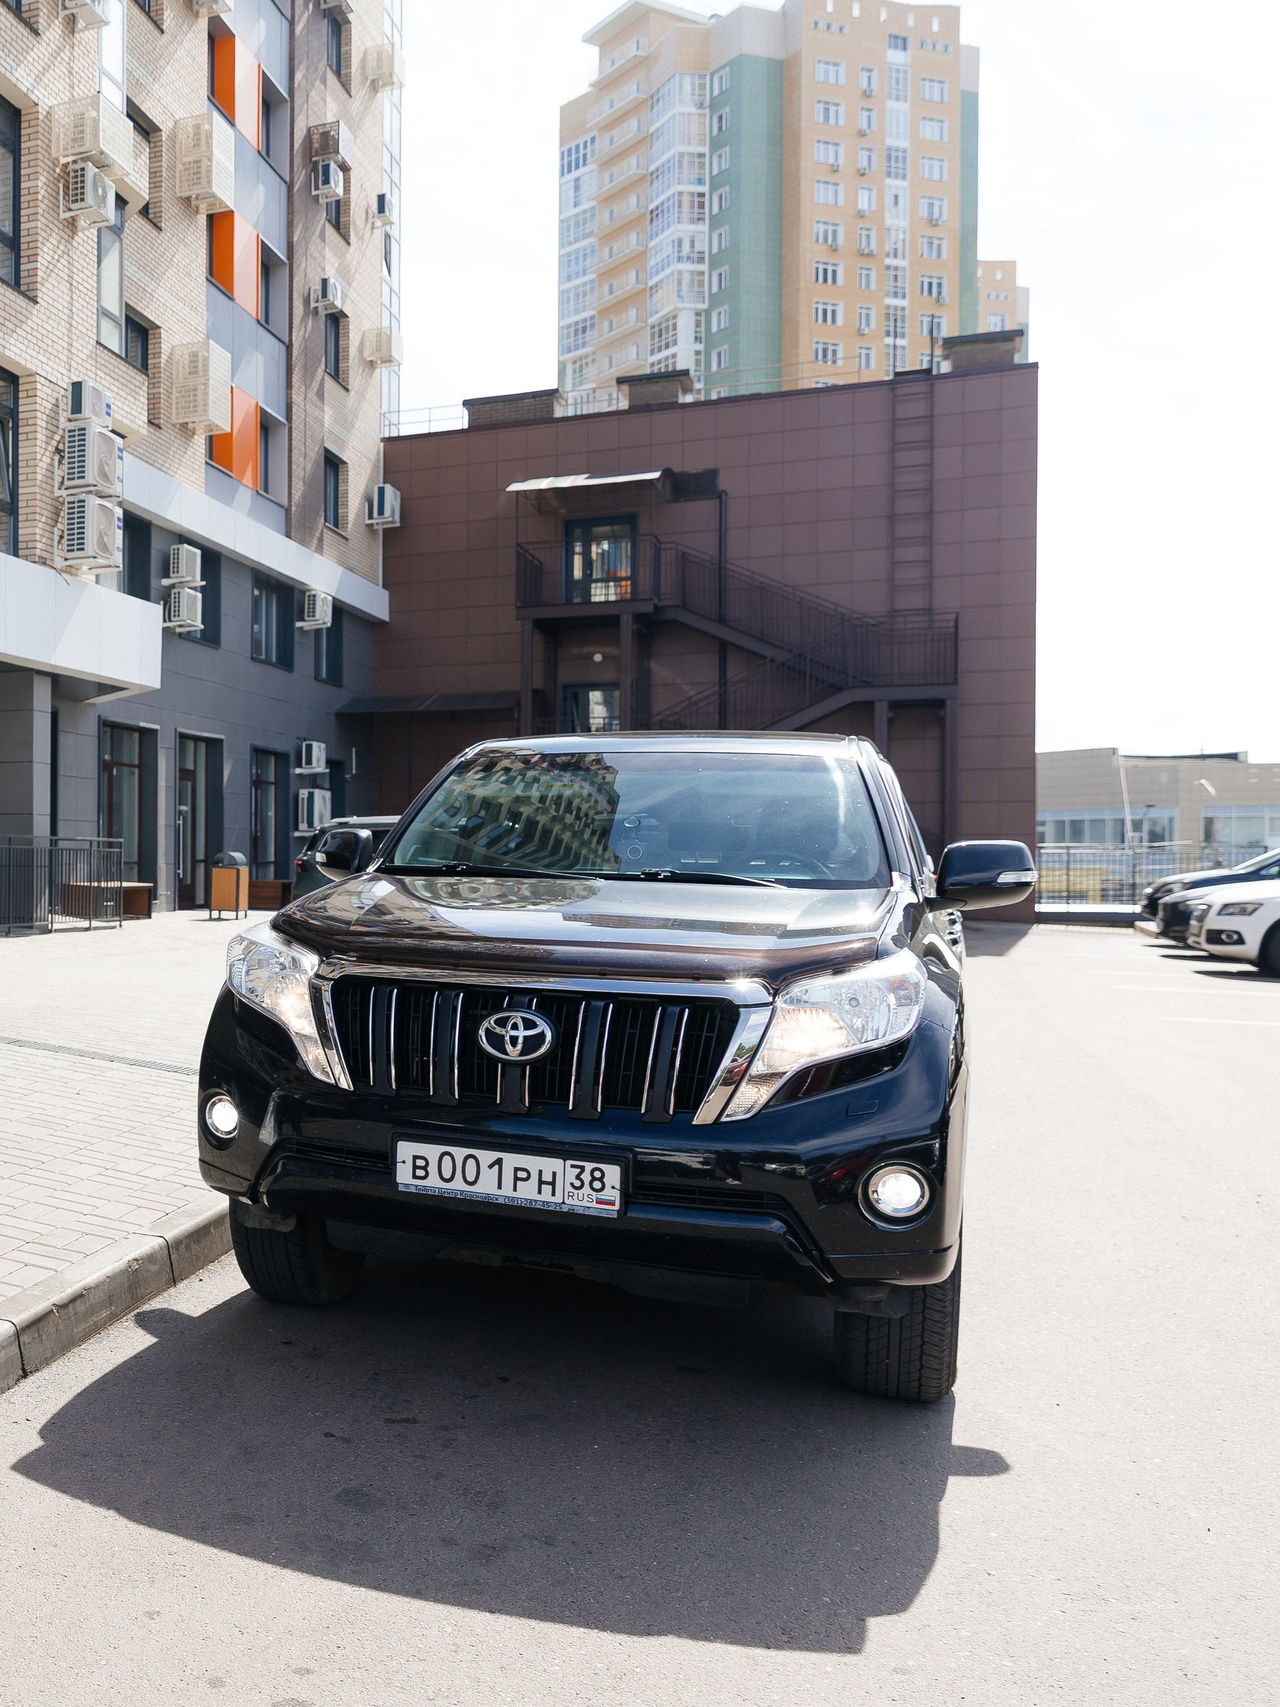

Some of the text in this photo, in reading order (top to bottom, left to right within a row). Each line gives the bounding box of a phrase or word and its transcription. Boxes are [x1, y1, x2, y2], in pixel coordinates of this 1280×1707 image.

[411, 1151, 606, 1197] В001РН 38
[567, 1191, 594, 1203] RUS
